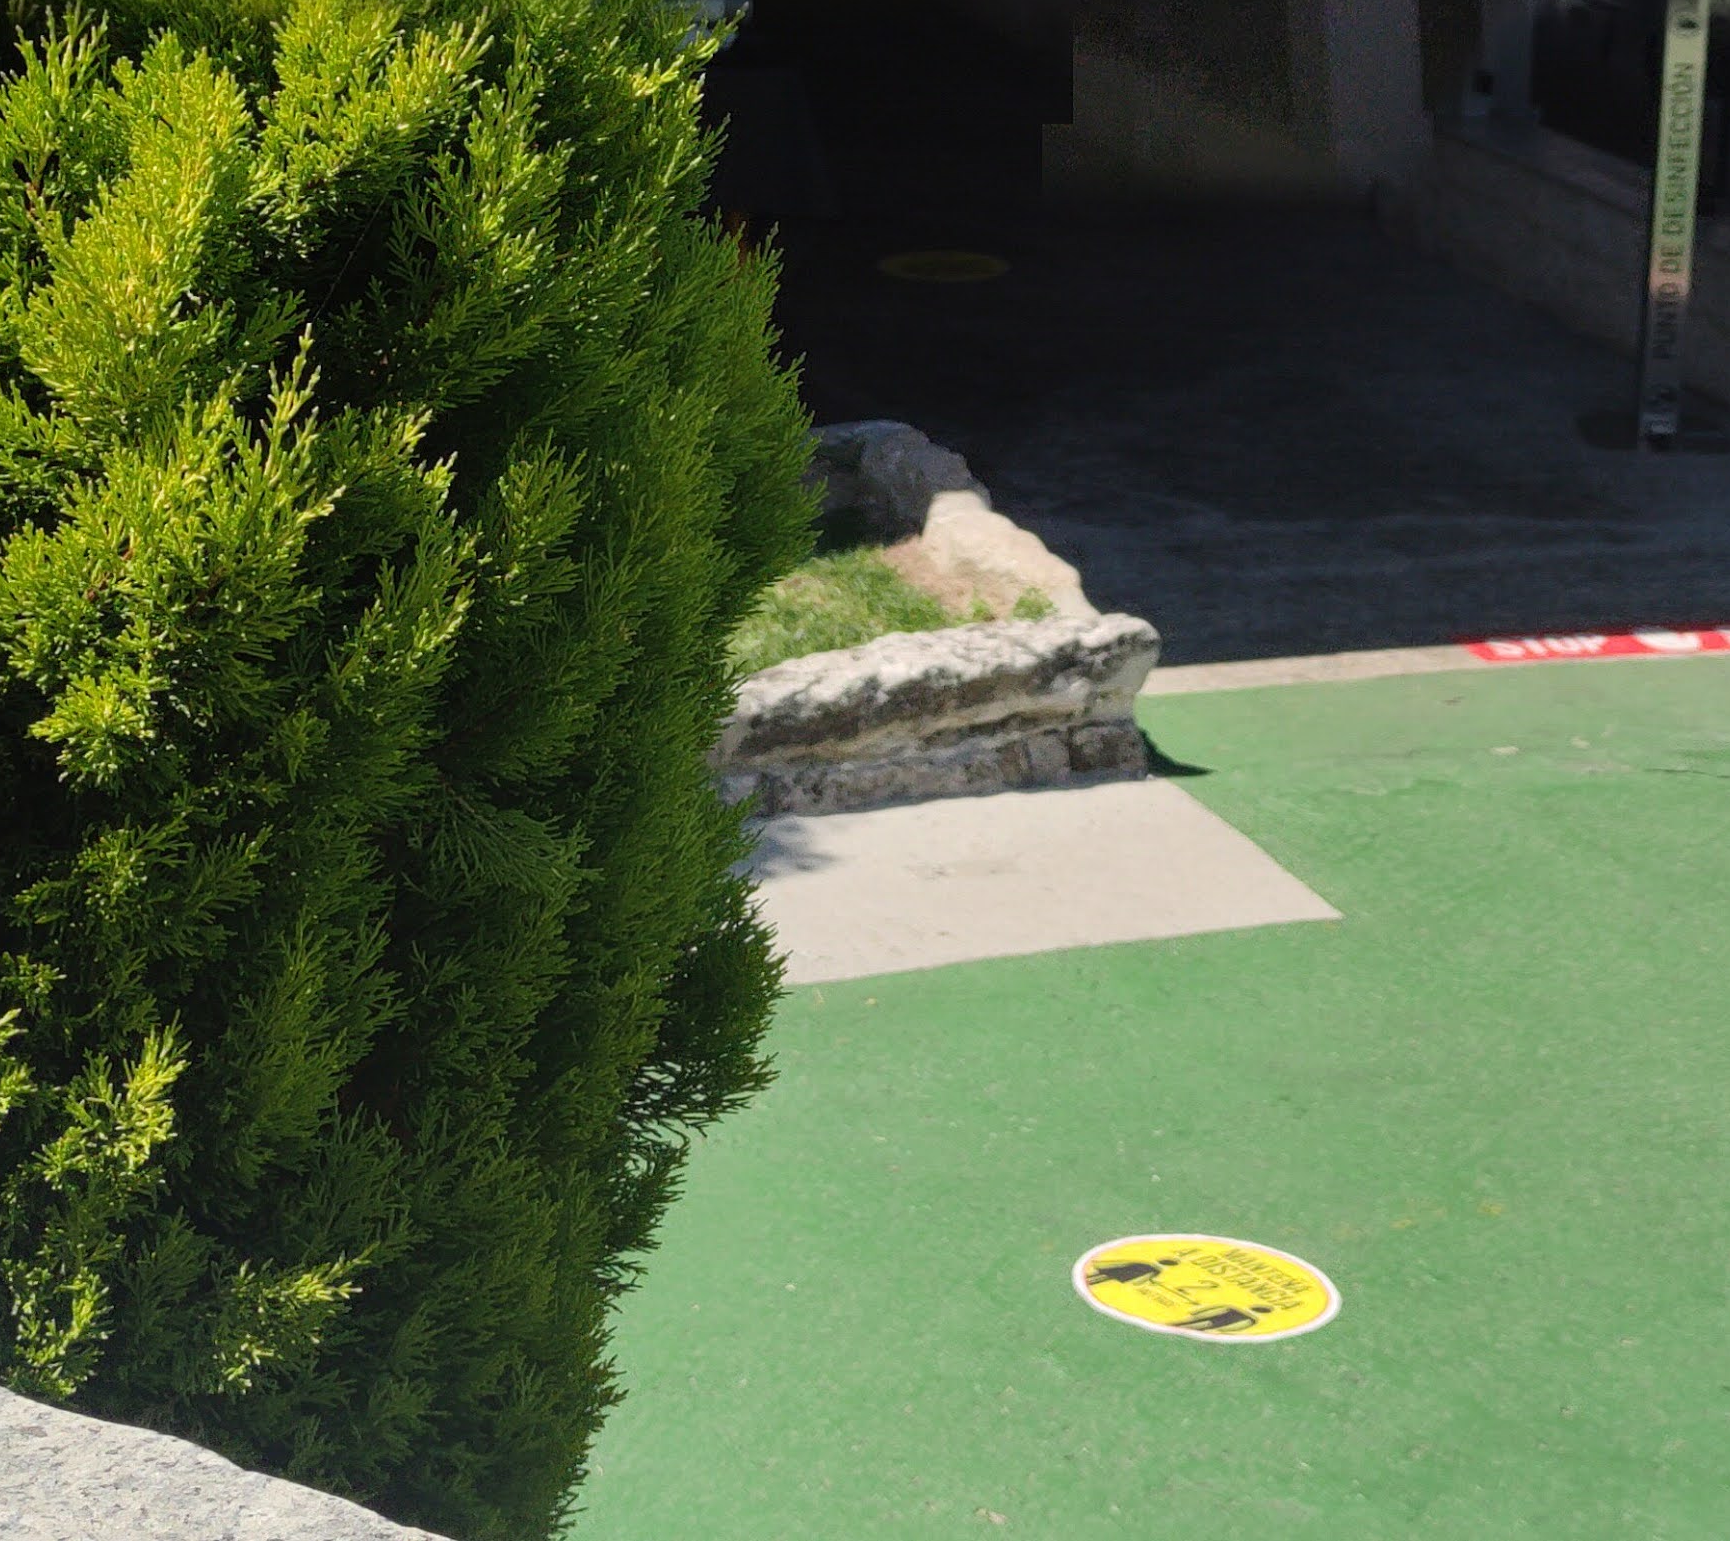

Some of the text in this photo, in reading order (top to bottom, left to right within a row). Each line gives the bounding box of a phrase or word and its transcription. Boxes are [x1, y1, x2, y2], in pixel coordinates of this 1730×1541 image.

[1661, 62, 1693, 236] DESINFECCIÓN
[1659, 244, 1684, 274] DE
[1486, 633, 1607, 658] STOP
[1175, 1279, 1220, 1294] 2
[1190, 1255, 1303, 1310] DISTANCIA
